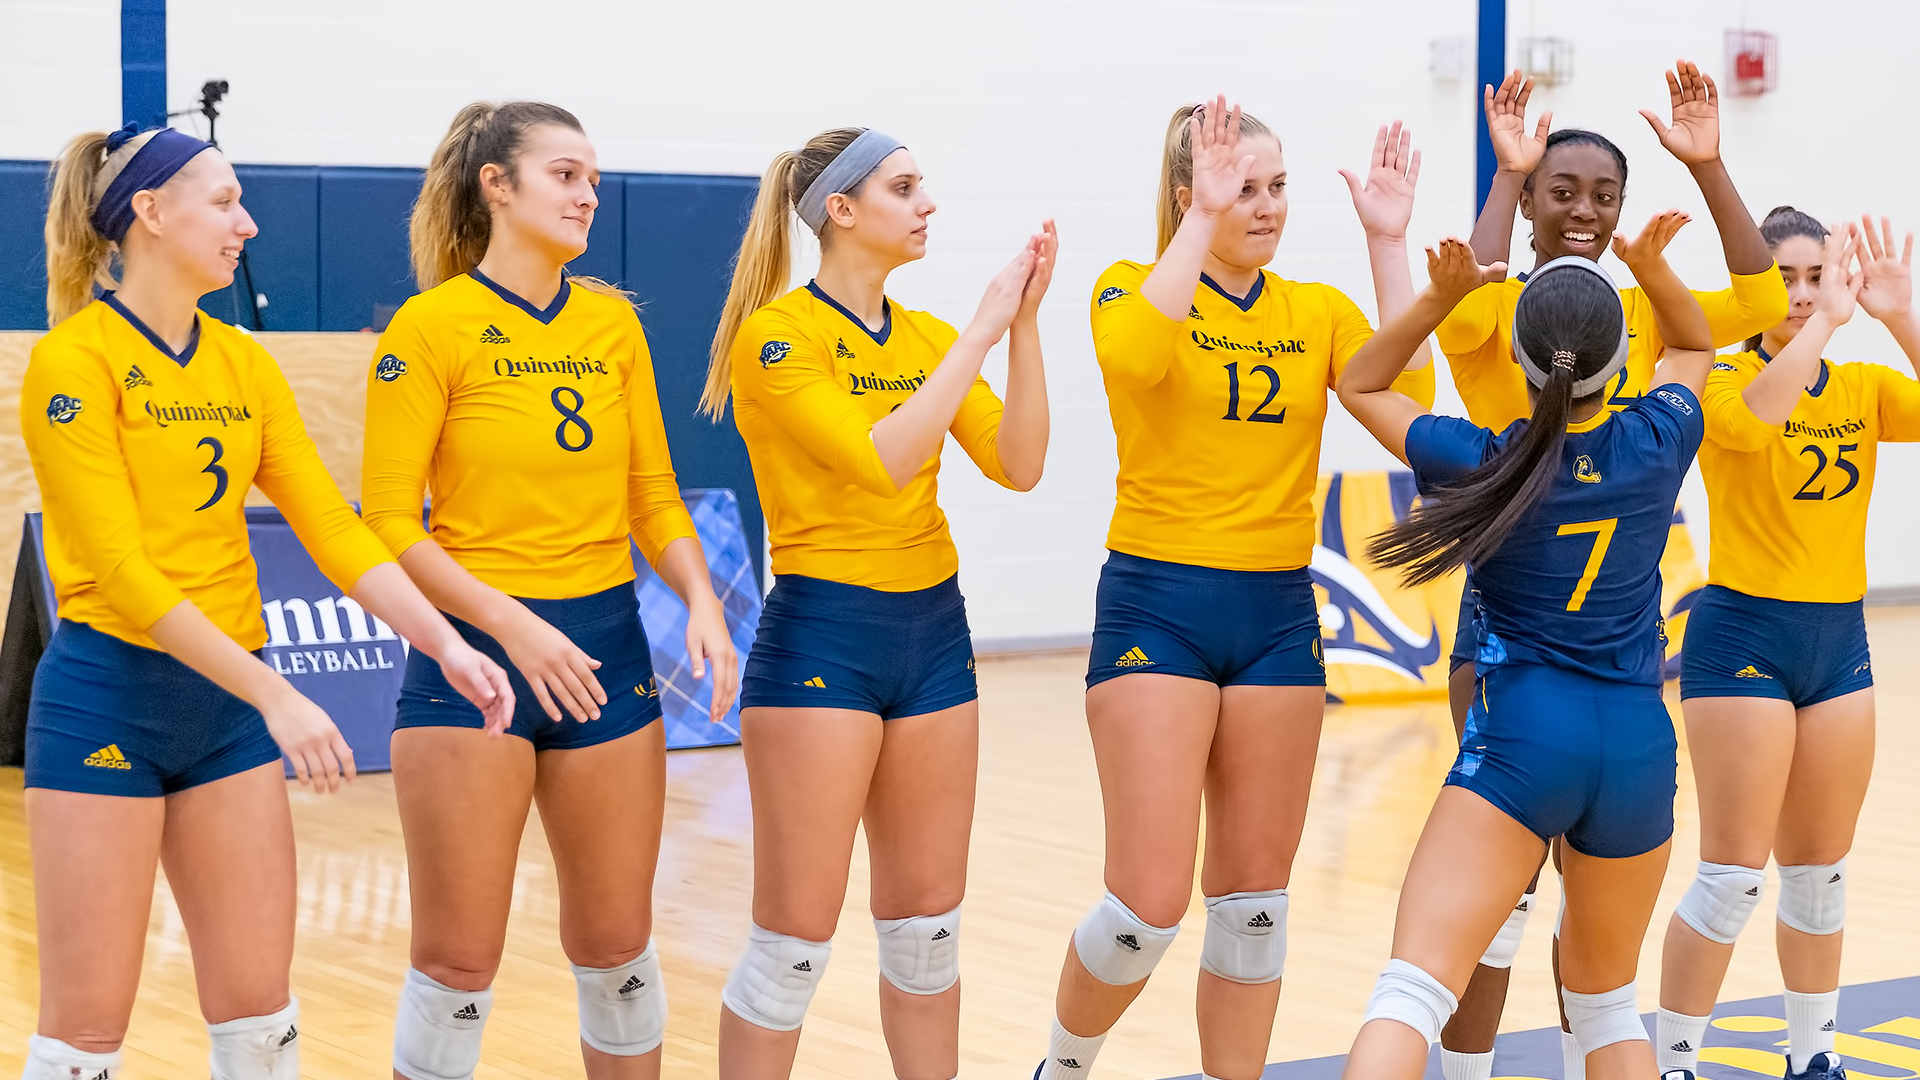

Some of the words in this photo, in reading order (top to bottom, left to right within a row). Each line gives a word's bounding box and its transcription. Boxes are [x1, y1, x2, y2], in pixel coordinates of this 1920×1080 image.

[479, 336, 511, 344] adidas
[1191, 330, 1306, 358] Quinnipiac
[494, 355, 608, 380] Quinnipia
[1221, 361, 1286, 424] 12
[550, 386, 594, 453] 8
[194, 436, 229, 513] 3
[1792, 442, 1860, 501] 25
[1556, 517, 1619, 612] 7
[271, 647, 394, 675] LEYBALL
[84, 758, 132, 770] adidas
